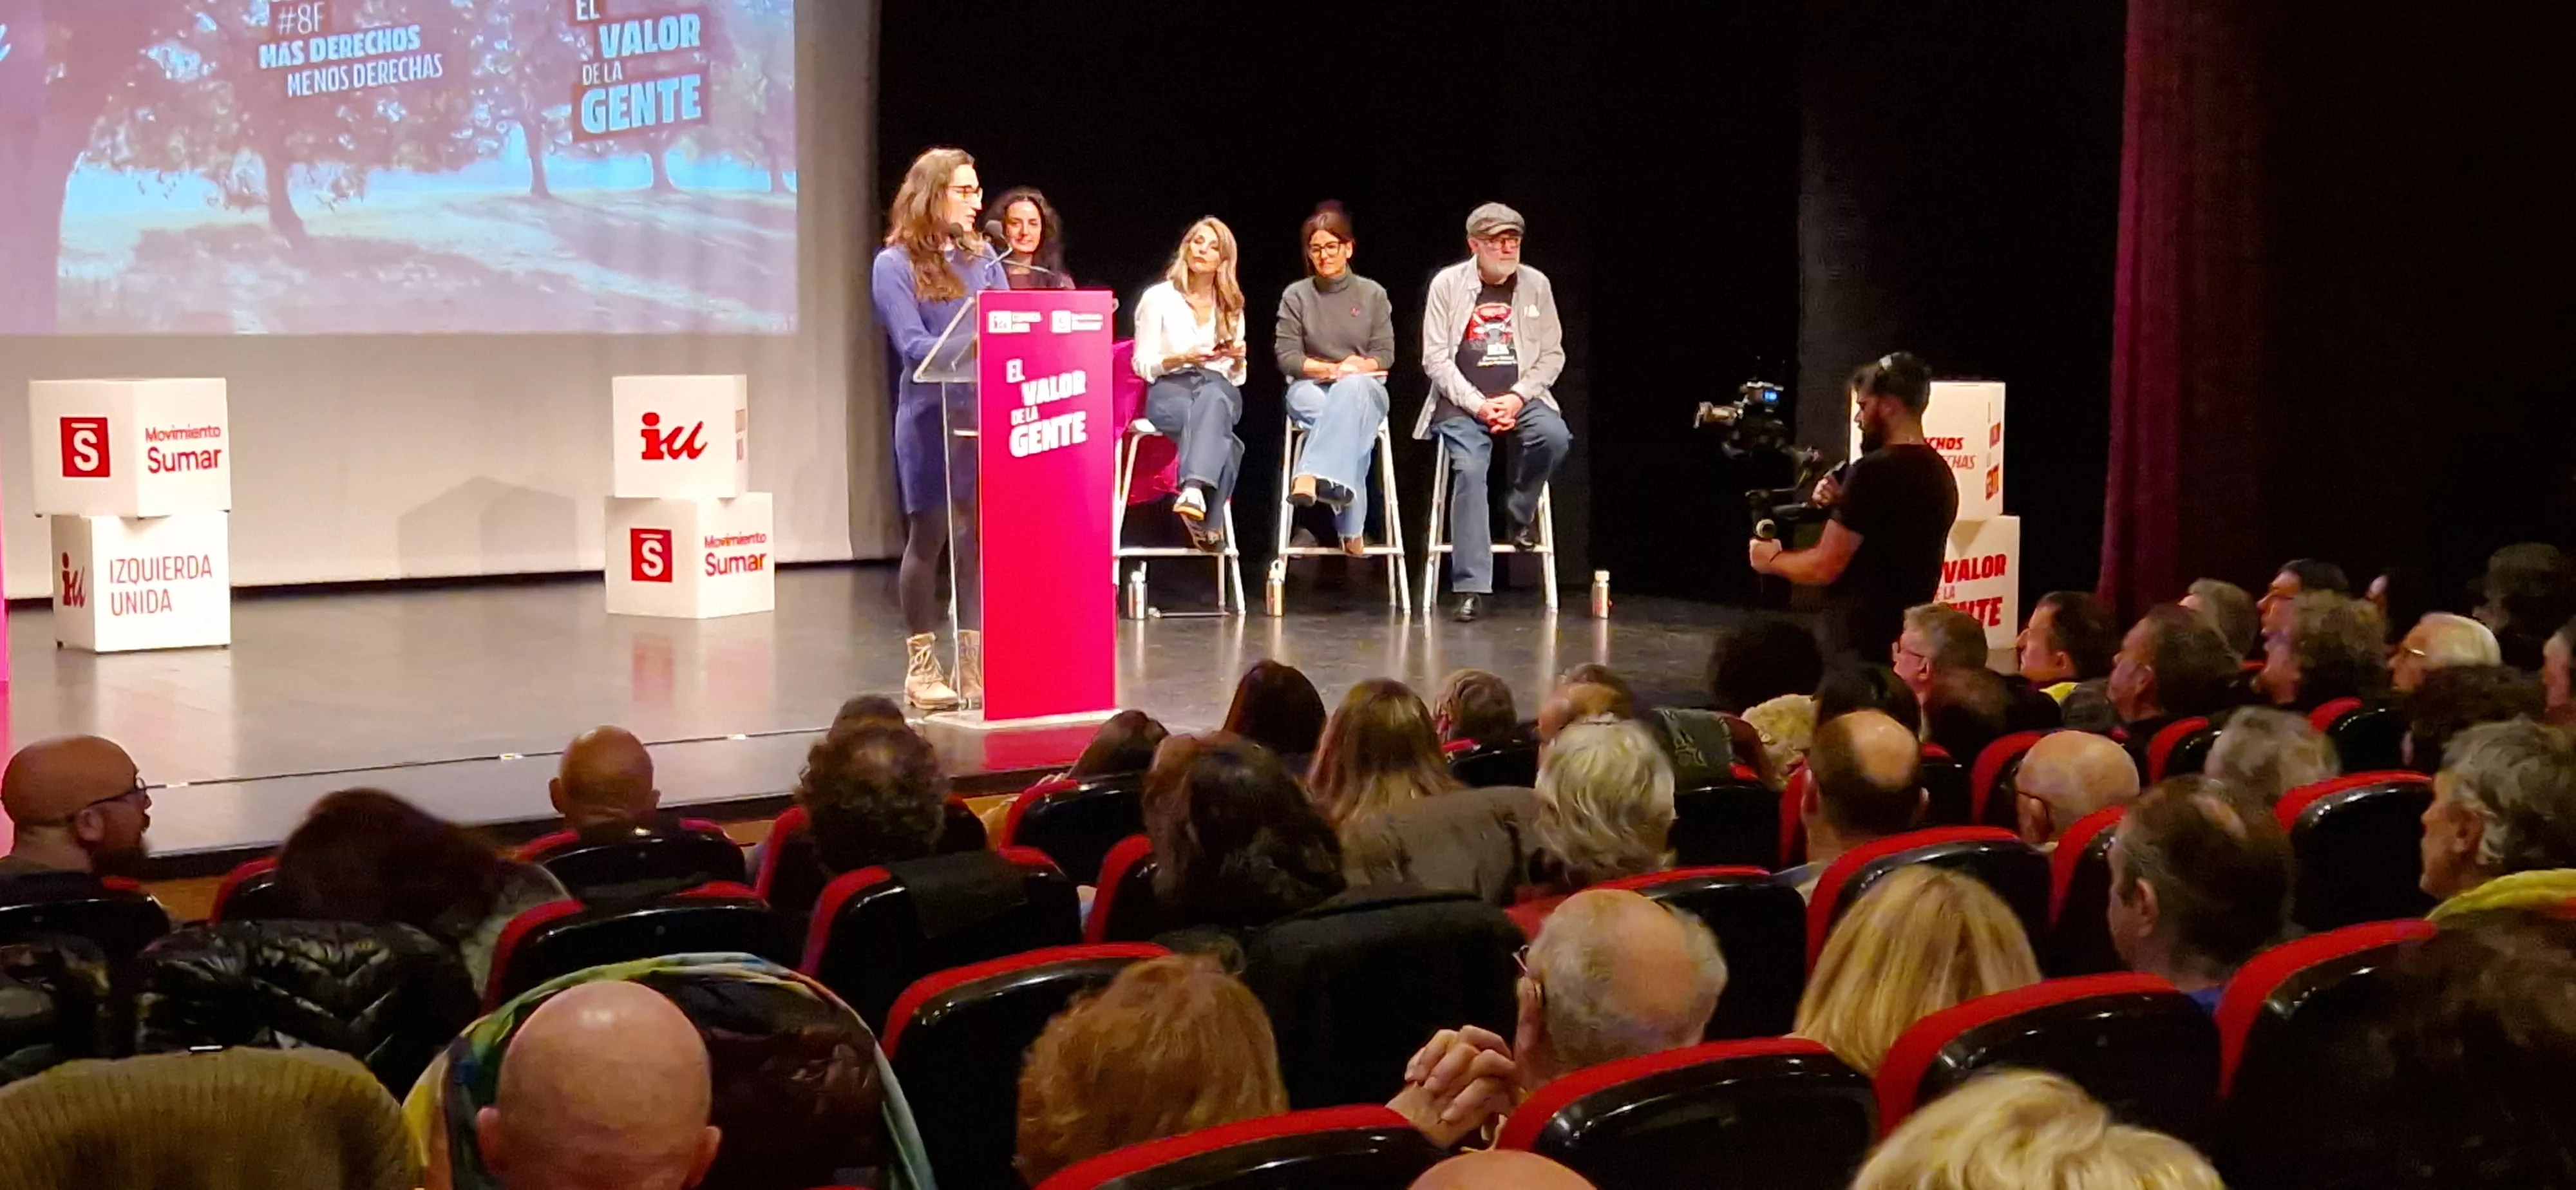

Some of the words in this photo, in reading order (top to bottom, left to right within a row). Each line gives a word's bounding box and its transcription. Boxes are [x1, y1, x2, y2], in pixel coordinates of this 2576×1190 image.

[276, 2, 325, 35] #8F
[576, 0, 600, 21] EL
[309, 25, 421, 62] DERECHOS
[599, 14, 700, 58] VALOR
[287, 66, 349, 97] MENOS
[354, 53, 443, 88] DERECHAS
[582, 63, 601, 85] DE
[604, 61, 623, 83] LA
[582, 74, 701, 133] GENTE
[1007, 359, 1025, 383] EL
[1021, 370, 1086, 406] VALOR
[1011, 409, 1025, 426] DE
[1025, 406, 1039, 422] LA
[146, 425, 220, 442] Movimiento
[641, 411, 708, 460] iu
[1010, 411, 1088, 457] GENTE
[147, 446, 222, 474] Sumar
[704, 532, 767, 549] Movimiento
[109, 554, 213, 585] IZQUIERDA
[705, 552, 767, 577] Sumar
[1943, 554, 2006, 583] VALOR
[111, 589, 173, 616] UNIDA
